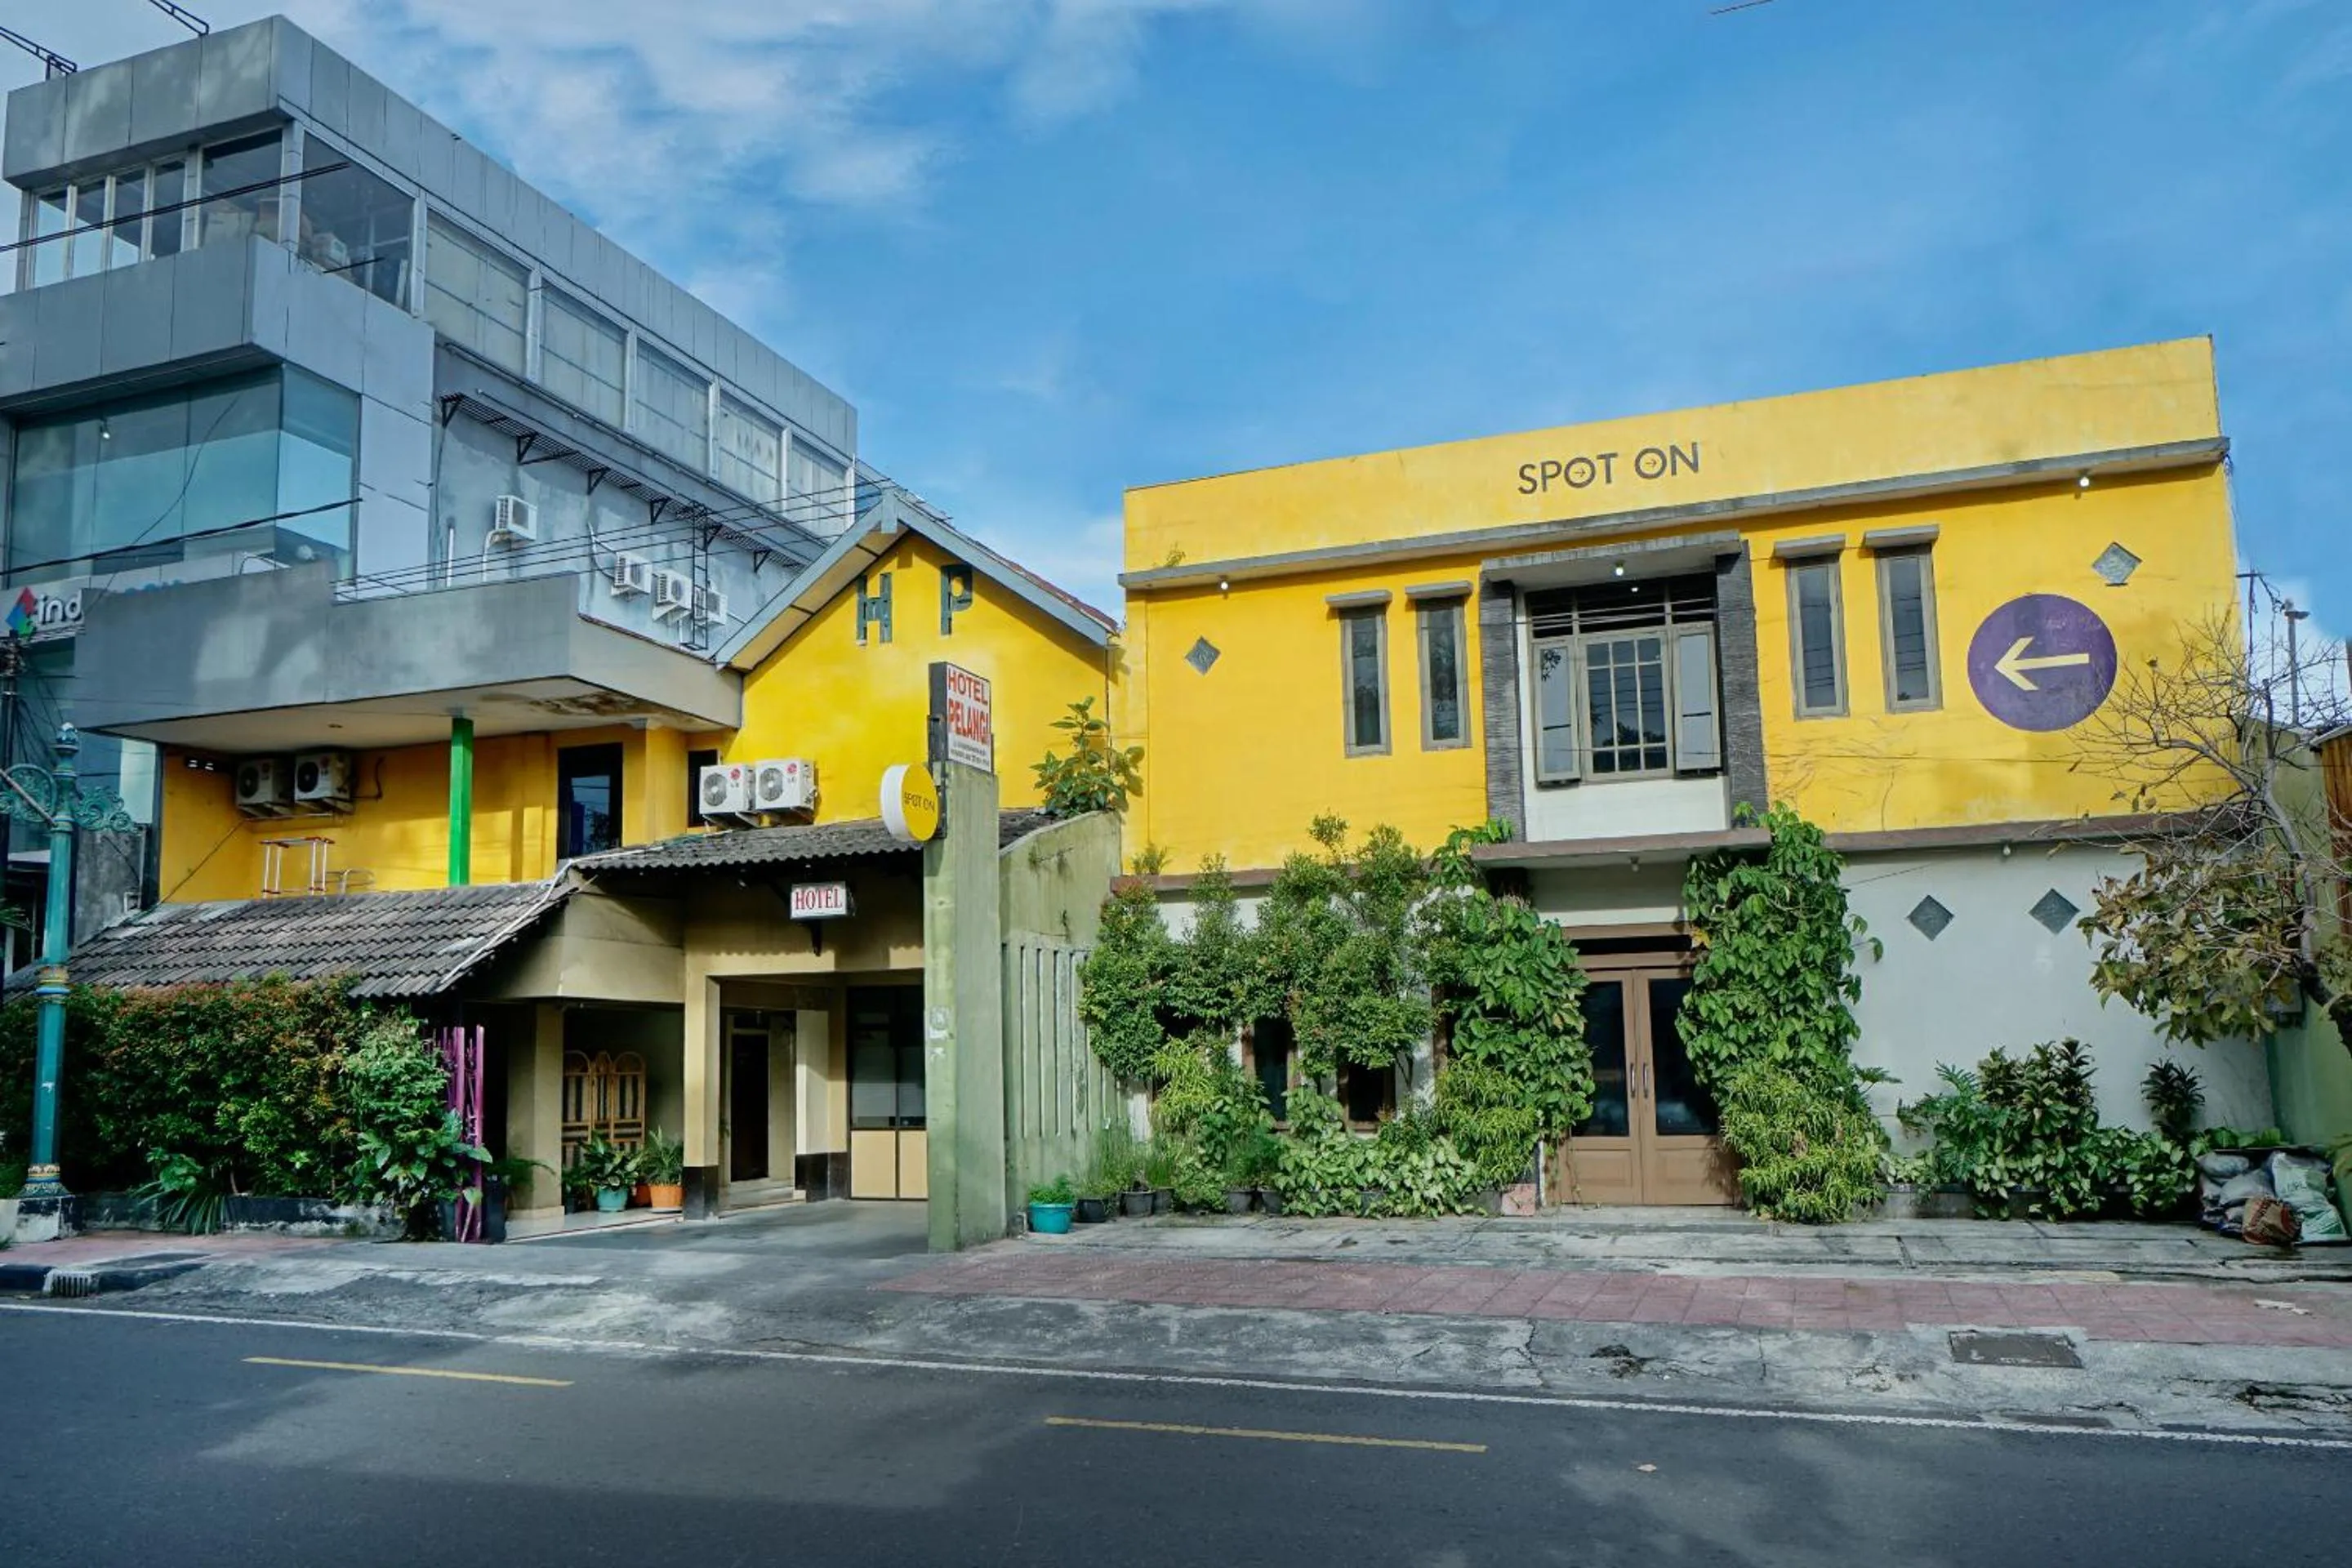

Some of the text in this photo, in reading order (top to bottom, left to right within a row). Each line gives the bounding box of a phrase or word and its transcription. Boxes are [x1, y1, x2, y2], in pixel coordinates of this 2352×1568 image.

[1517, 442, 1699, 495] SPOT ON
[948, 667, 988, 706] HOTEL
[948, 697, 989, 746] PELANGI
[904, 791, 935, 813] SPOT ON
[795, 888, 843, 911] HOTEL
